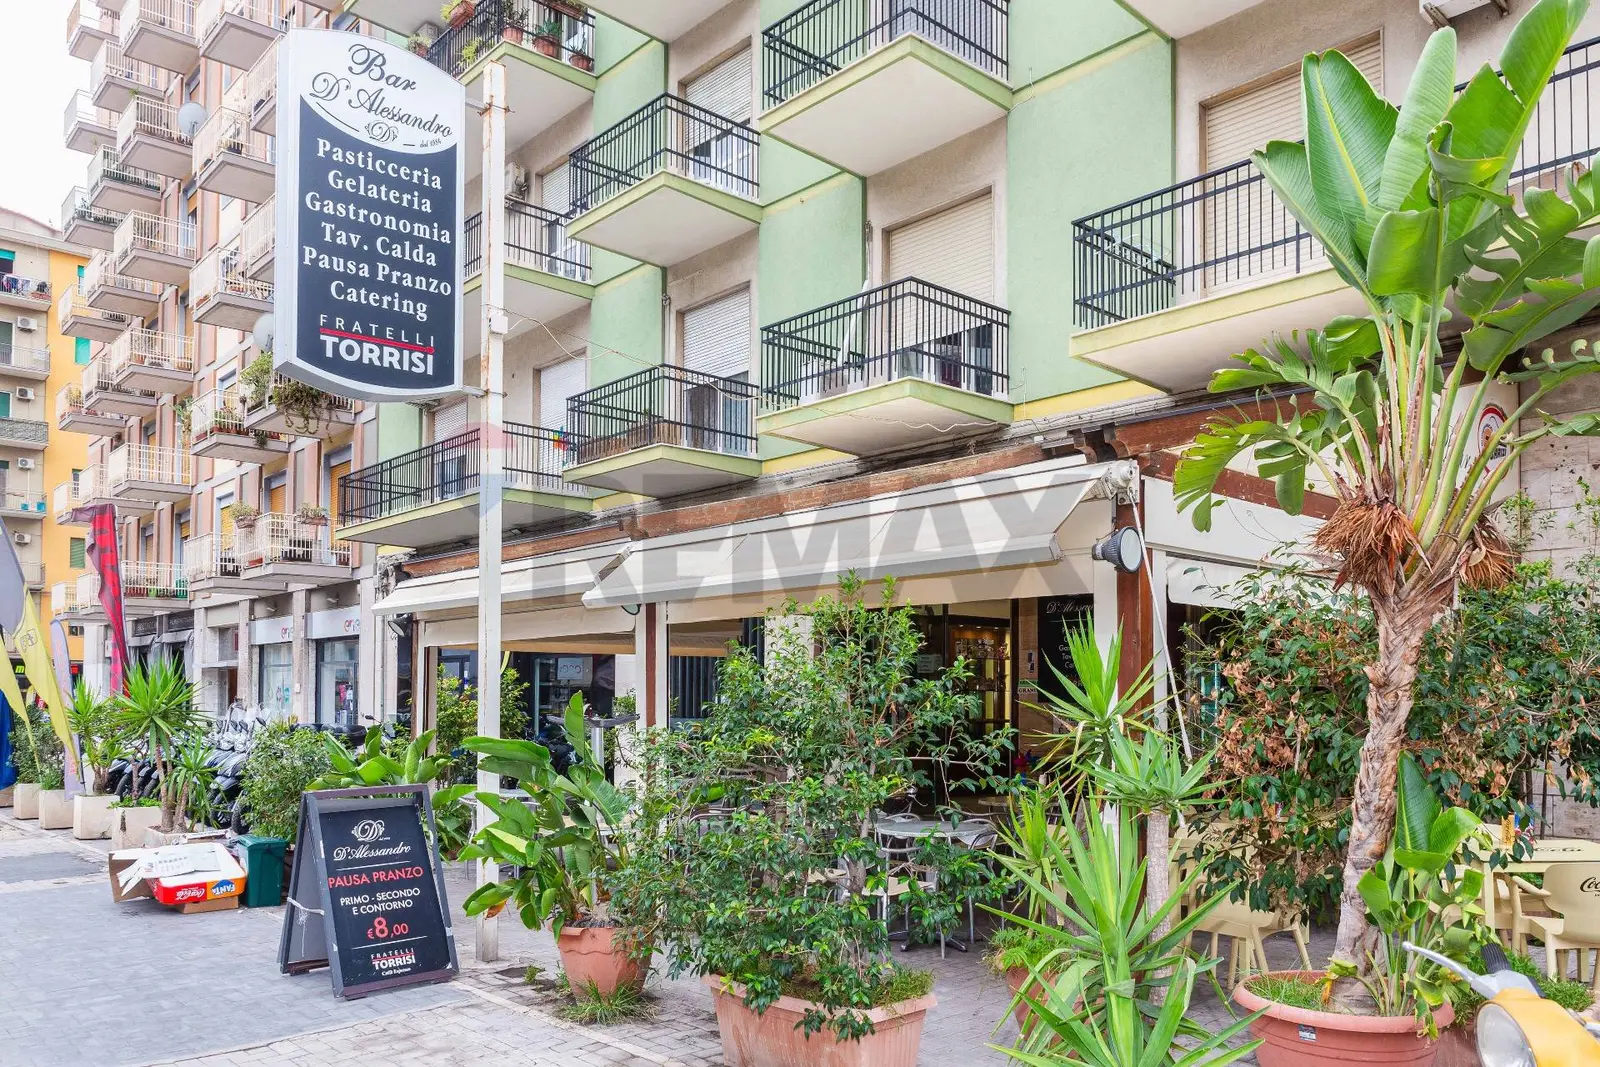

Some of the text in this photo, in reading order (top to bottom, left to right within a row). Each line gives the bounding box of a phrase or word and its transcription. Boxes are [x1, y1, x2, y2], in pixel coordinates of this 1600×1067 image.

[348, 44, 416, 91] Bar
[317, 138, 442, 190] Pasticceria
[328, 170, 432, 213] Gelateria
[305, 192, 451, 244] Gastronomia
[321, 222, 437, 267] Tav. Calda
[303, 245, 452, 296] Pausa Pranzo
[330, 280, 428, 322] Catering
[320, 314, 434, 347] FRATELLI
[320, 334, 434, 376] TORRISI
[333, 842, 411, 861] D'Alessandro
[328, 866, 424, 889] PAUSA PRANZO
[340, 894, 370, 906] PRIMO
[376, 887, 420, 901] SECONDO
[352, 899, 413, 915] E CONTORNO
[370, 947, 414, 959] FRATELLI
[372, 954, 416, 970] TORRISI
